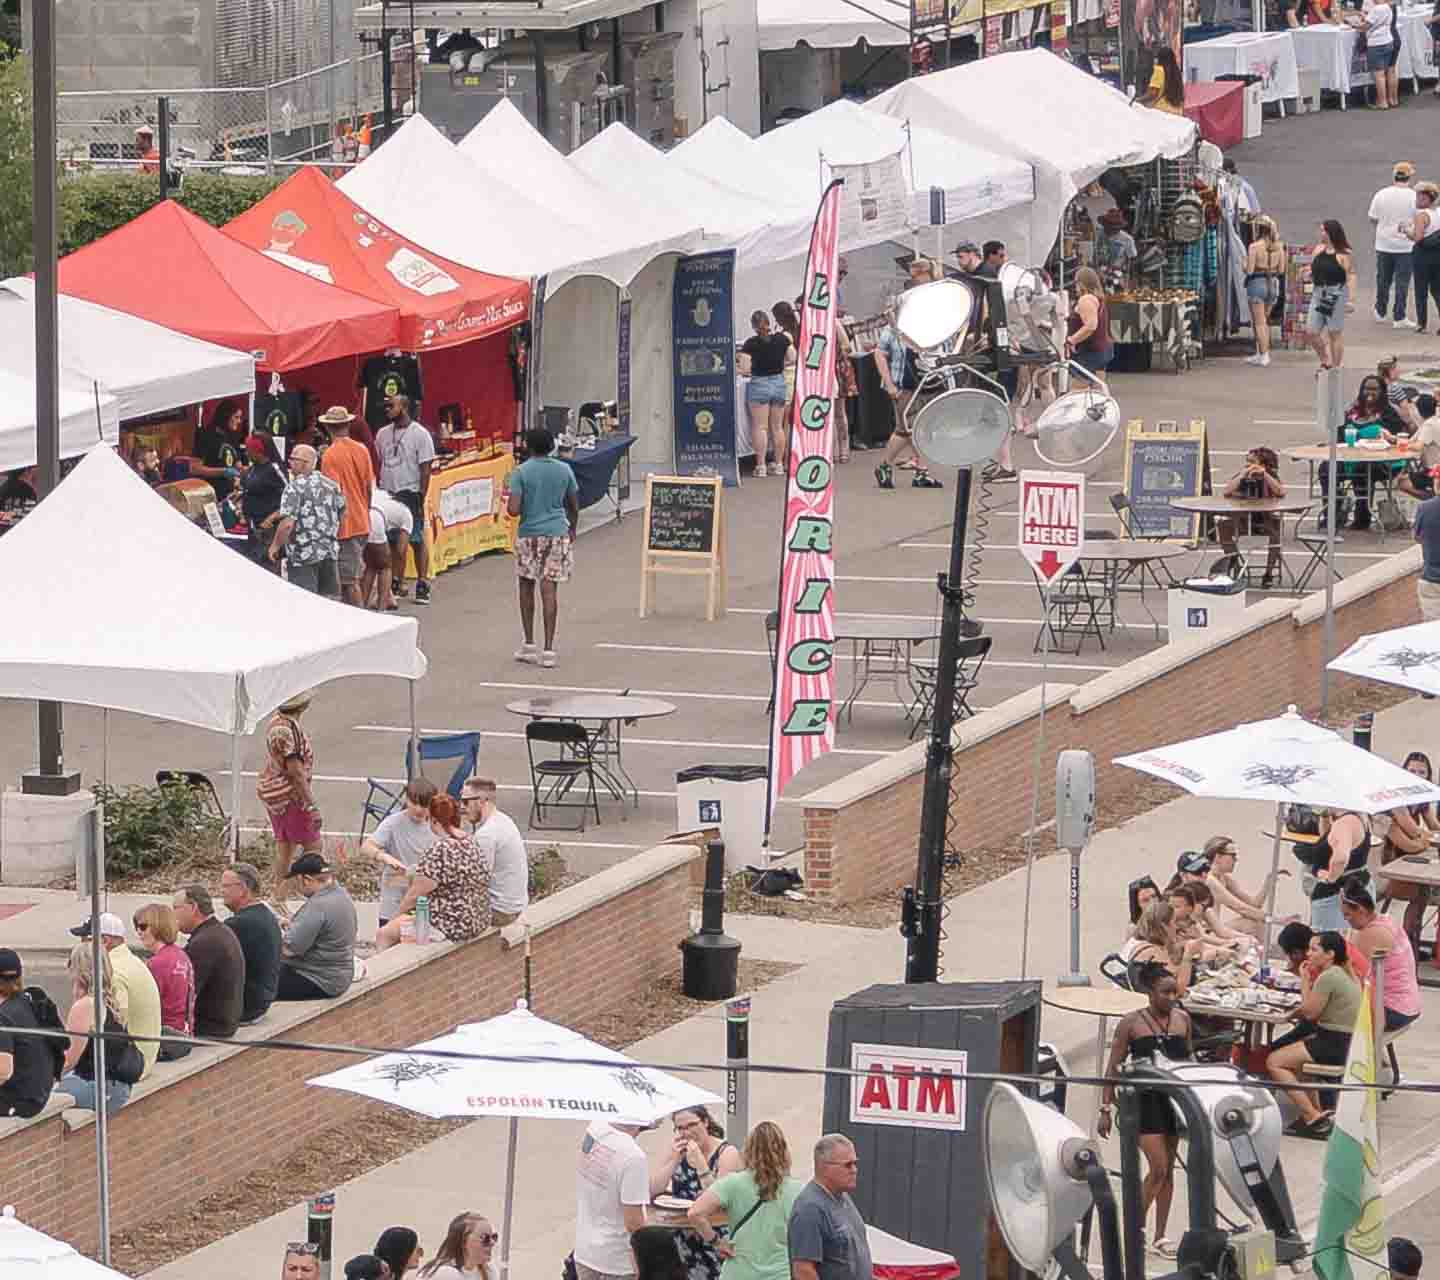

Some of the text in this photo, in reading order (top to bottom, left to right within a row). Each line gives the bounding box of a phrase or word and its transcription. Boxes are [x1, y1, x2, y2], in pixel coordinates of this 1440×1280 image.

[782, 272, 833, 736] LICORICE
[1024, 485, 1078, 528] ATM
[1024, 526, 1078, 545] HERE
[547, 1098, 619, 1113] TEQUILA
[860, 1063, 956, 1116] ATM
